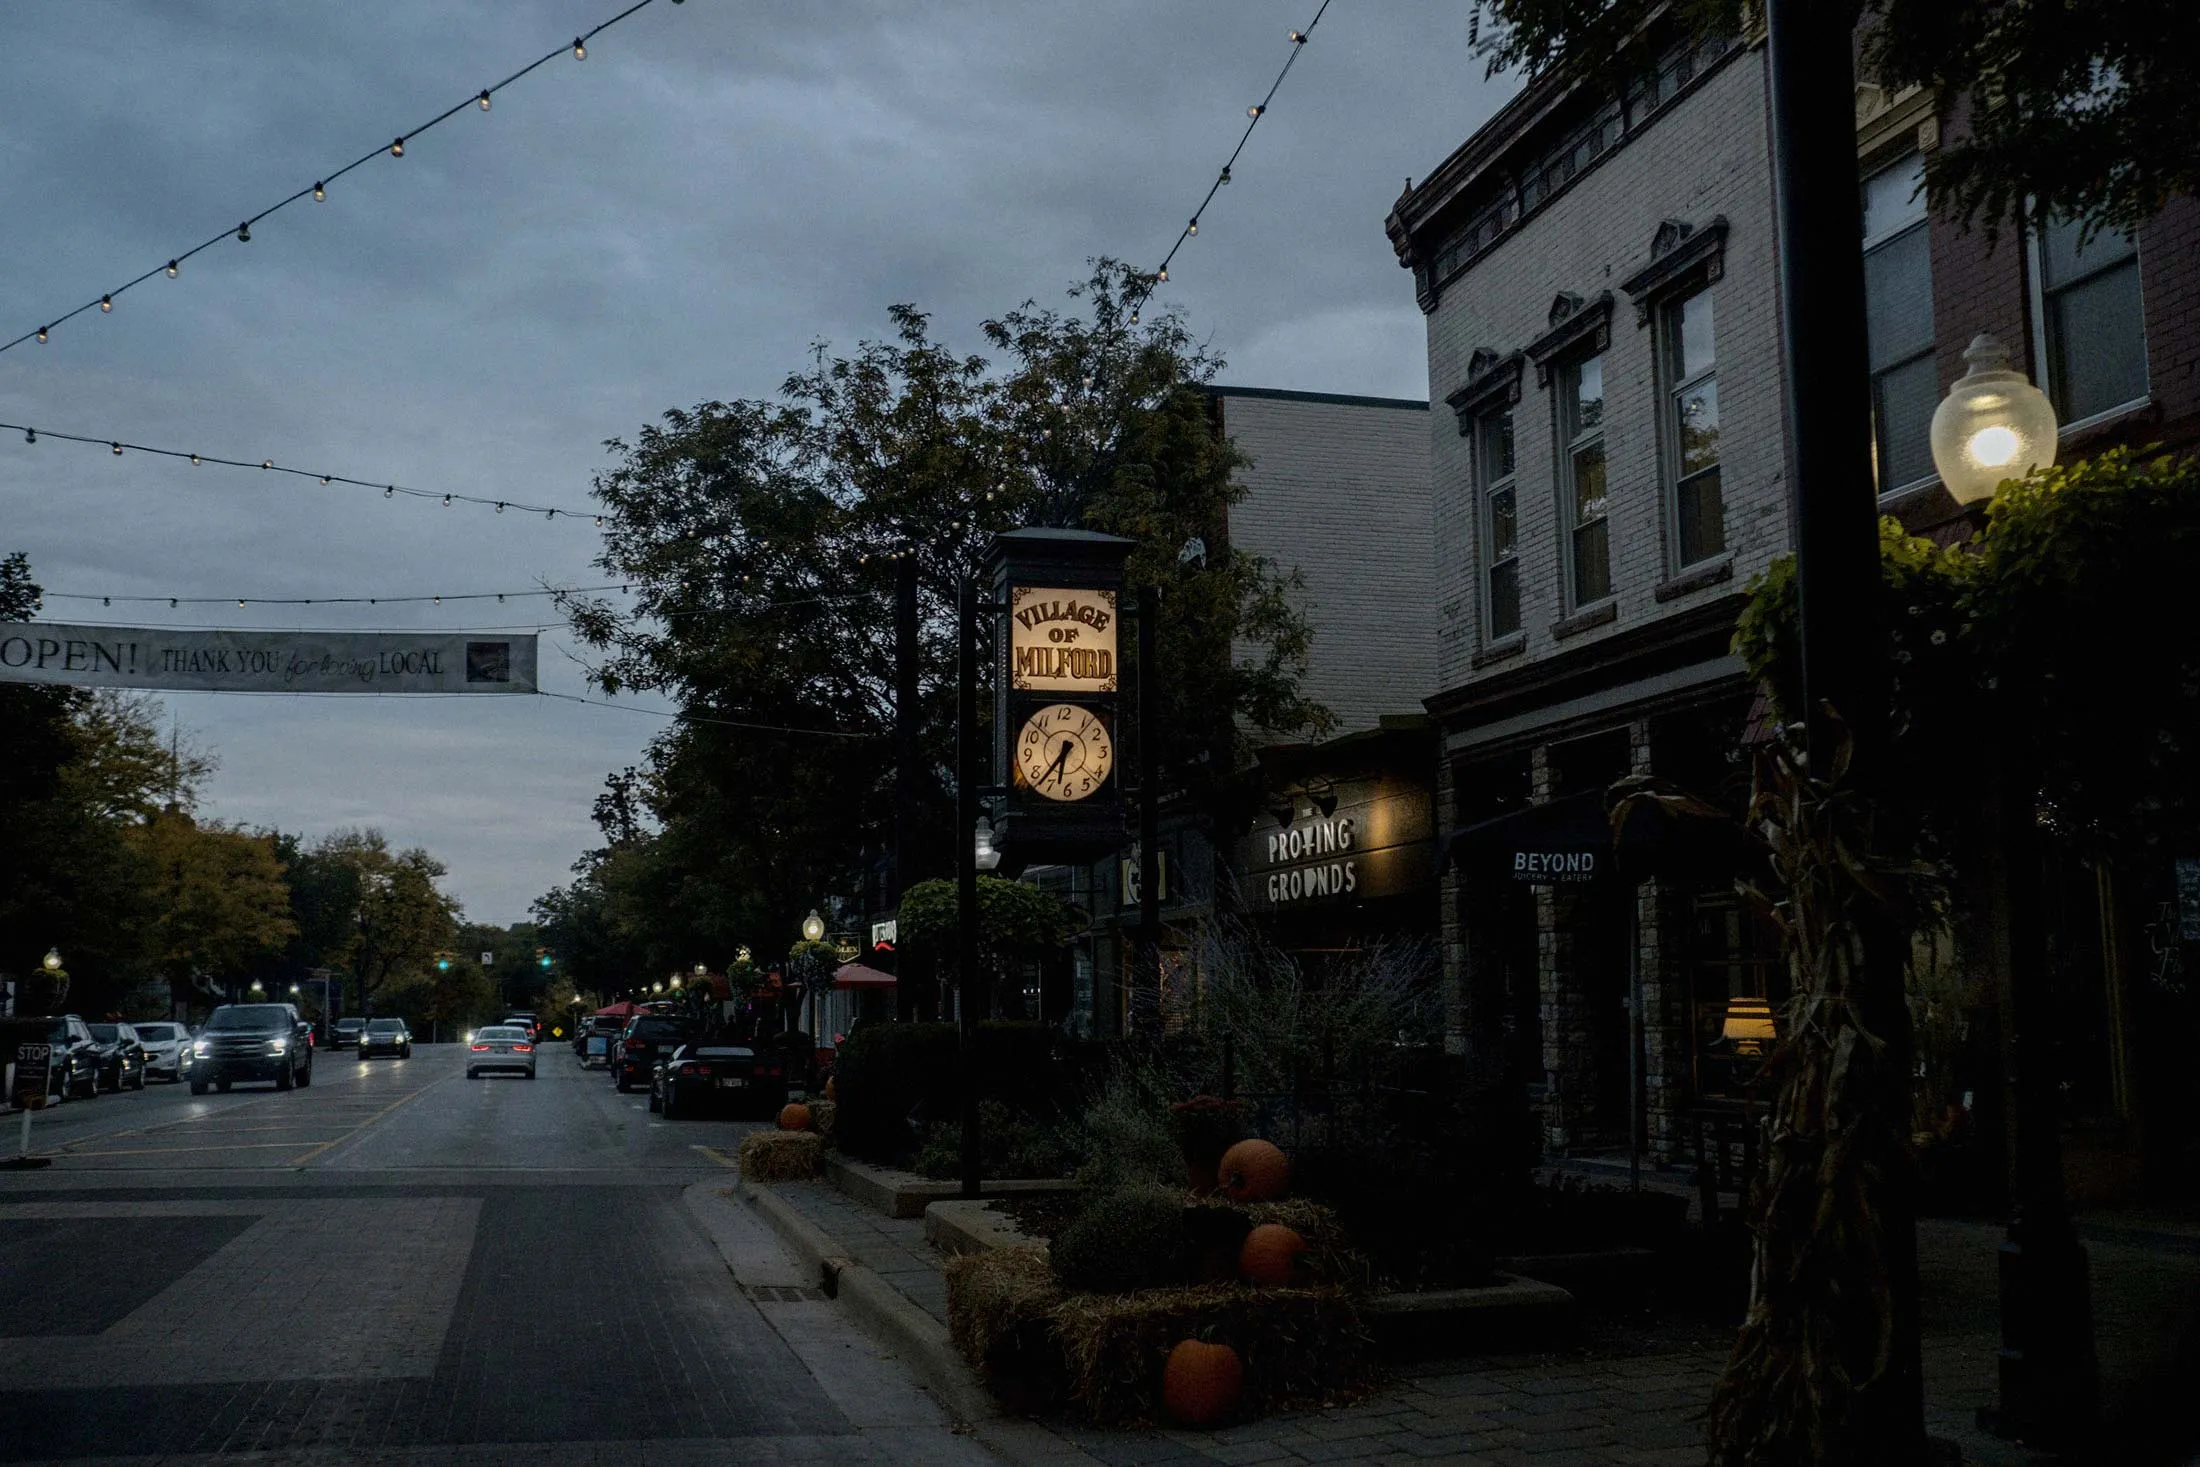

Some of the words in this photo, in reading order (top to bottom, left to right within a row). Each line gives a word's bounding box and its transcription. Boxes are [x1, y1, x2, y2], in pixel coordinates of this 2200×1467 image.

[1014, 600, 1111, 633] VILLAGE
[1049, 628, 1079, 643] OF
[1, 637, 137, 674] OPEN!
[161, 649, 230, 673] THANK
[238, 650, 279, 673] YOU
[379, 650, 444, 674] LOCAL
[1015, 646, 1112, 680] MILFORD
[1057, 707, 1072, 720] 12
[1039, 715, 1049, 728] 11
[1025, 730, 1039, 744] 10
[1092, 727, 1101, 741] 2
[1023, 747, 1033, 763] 9
[1097, 745, 1108, 759] 3
[1030, 765, 1041, 780] 8
[1094, 764, 1103, 778] 4
[1046, 778, 1056, 792] 7
[1063, 782, 1072, 798] 6
[1081, 777, 1090, 792] 5
[1268, 818, 1350, 863] PROVING
[1514, 852, 1594, 872] BEYOND
[1268, 861, 1356, 903] GROUNDS
[1561, 873, 1593, 882] EATERY
[17, 1045, 50, 1061] STOP
